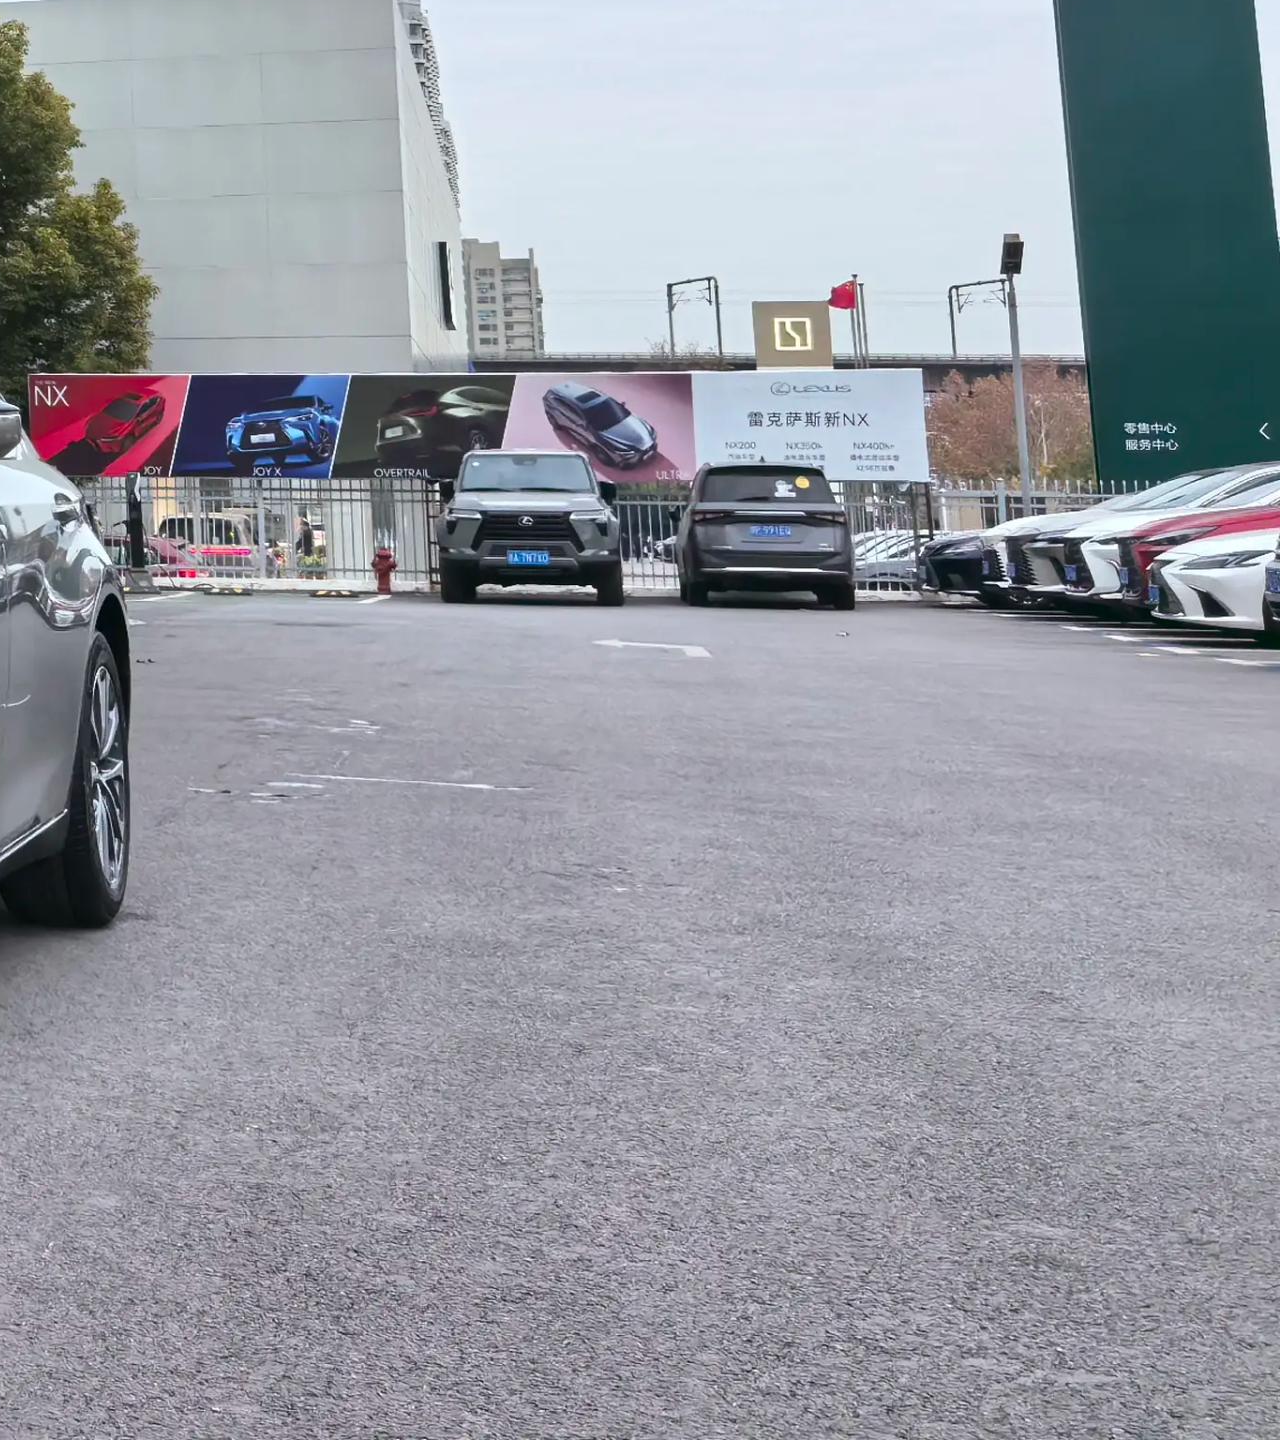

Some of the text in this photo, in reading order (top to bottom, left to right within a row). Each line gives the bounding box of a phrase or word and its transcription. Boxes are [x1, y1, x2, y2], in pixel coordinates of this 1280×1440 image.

[793, 383, 852, 393] LEXUS
[34, 385, 70, 407] NX
[747, 410, 870, 428] 雷克萨斯新NX
[1123, 422, 1177, 434] 零售中心
[725, 441, 756, 450] NX200
[1125, 439, 1179, 451] 服务中心
[143, 466, 163, 475] JOY
[253, 467, 282, 477] JOY X
[373, 468, 431, 478] OVERTRAIL
